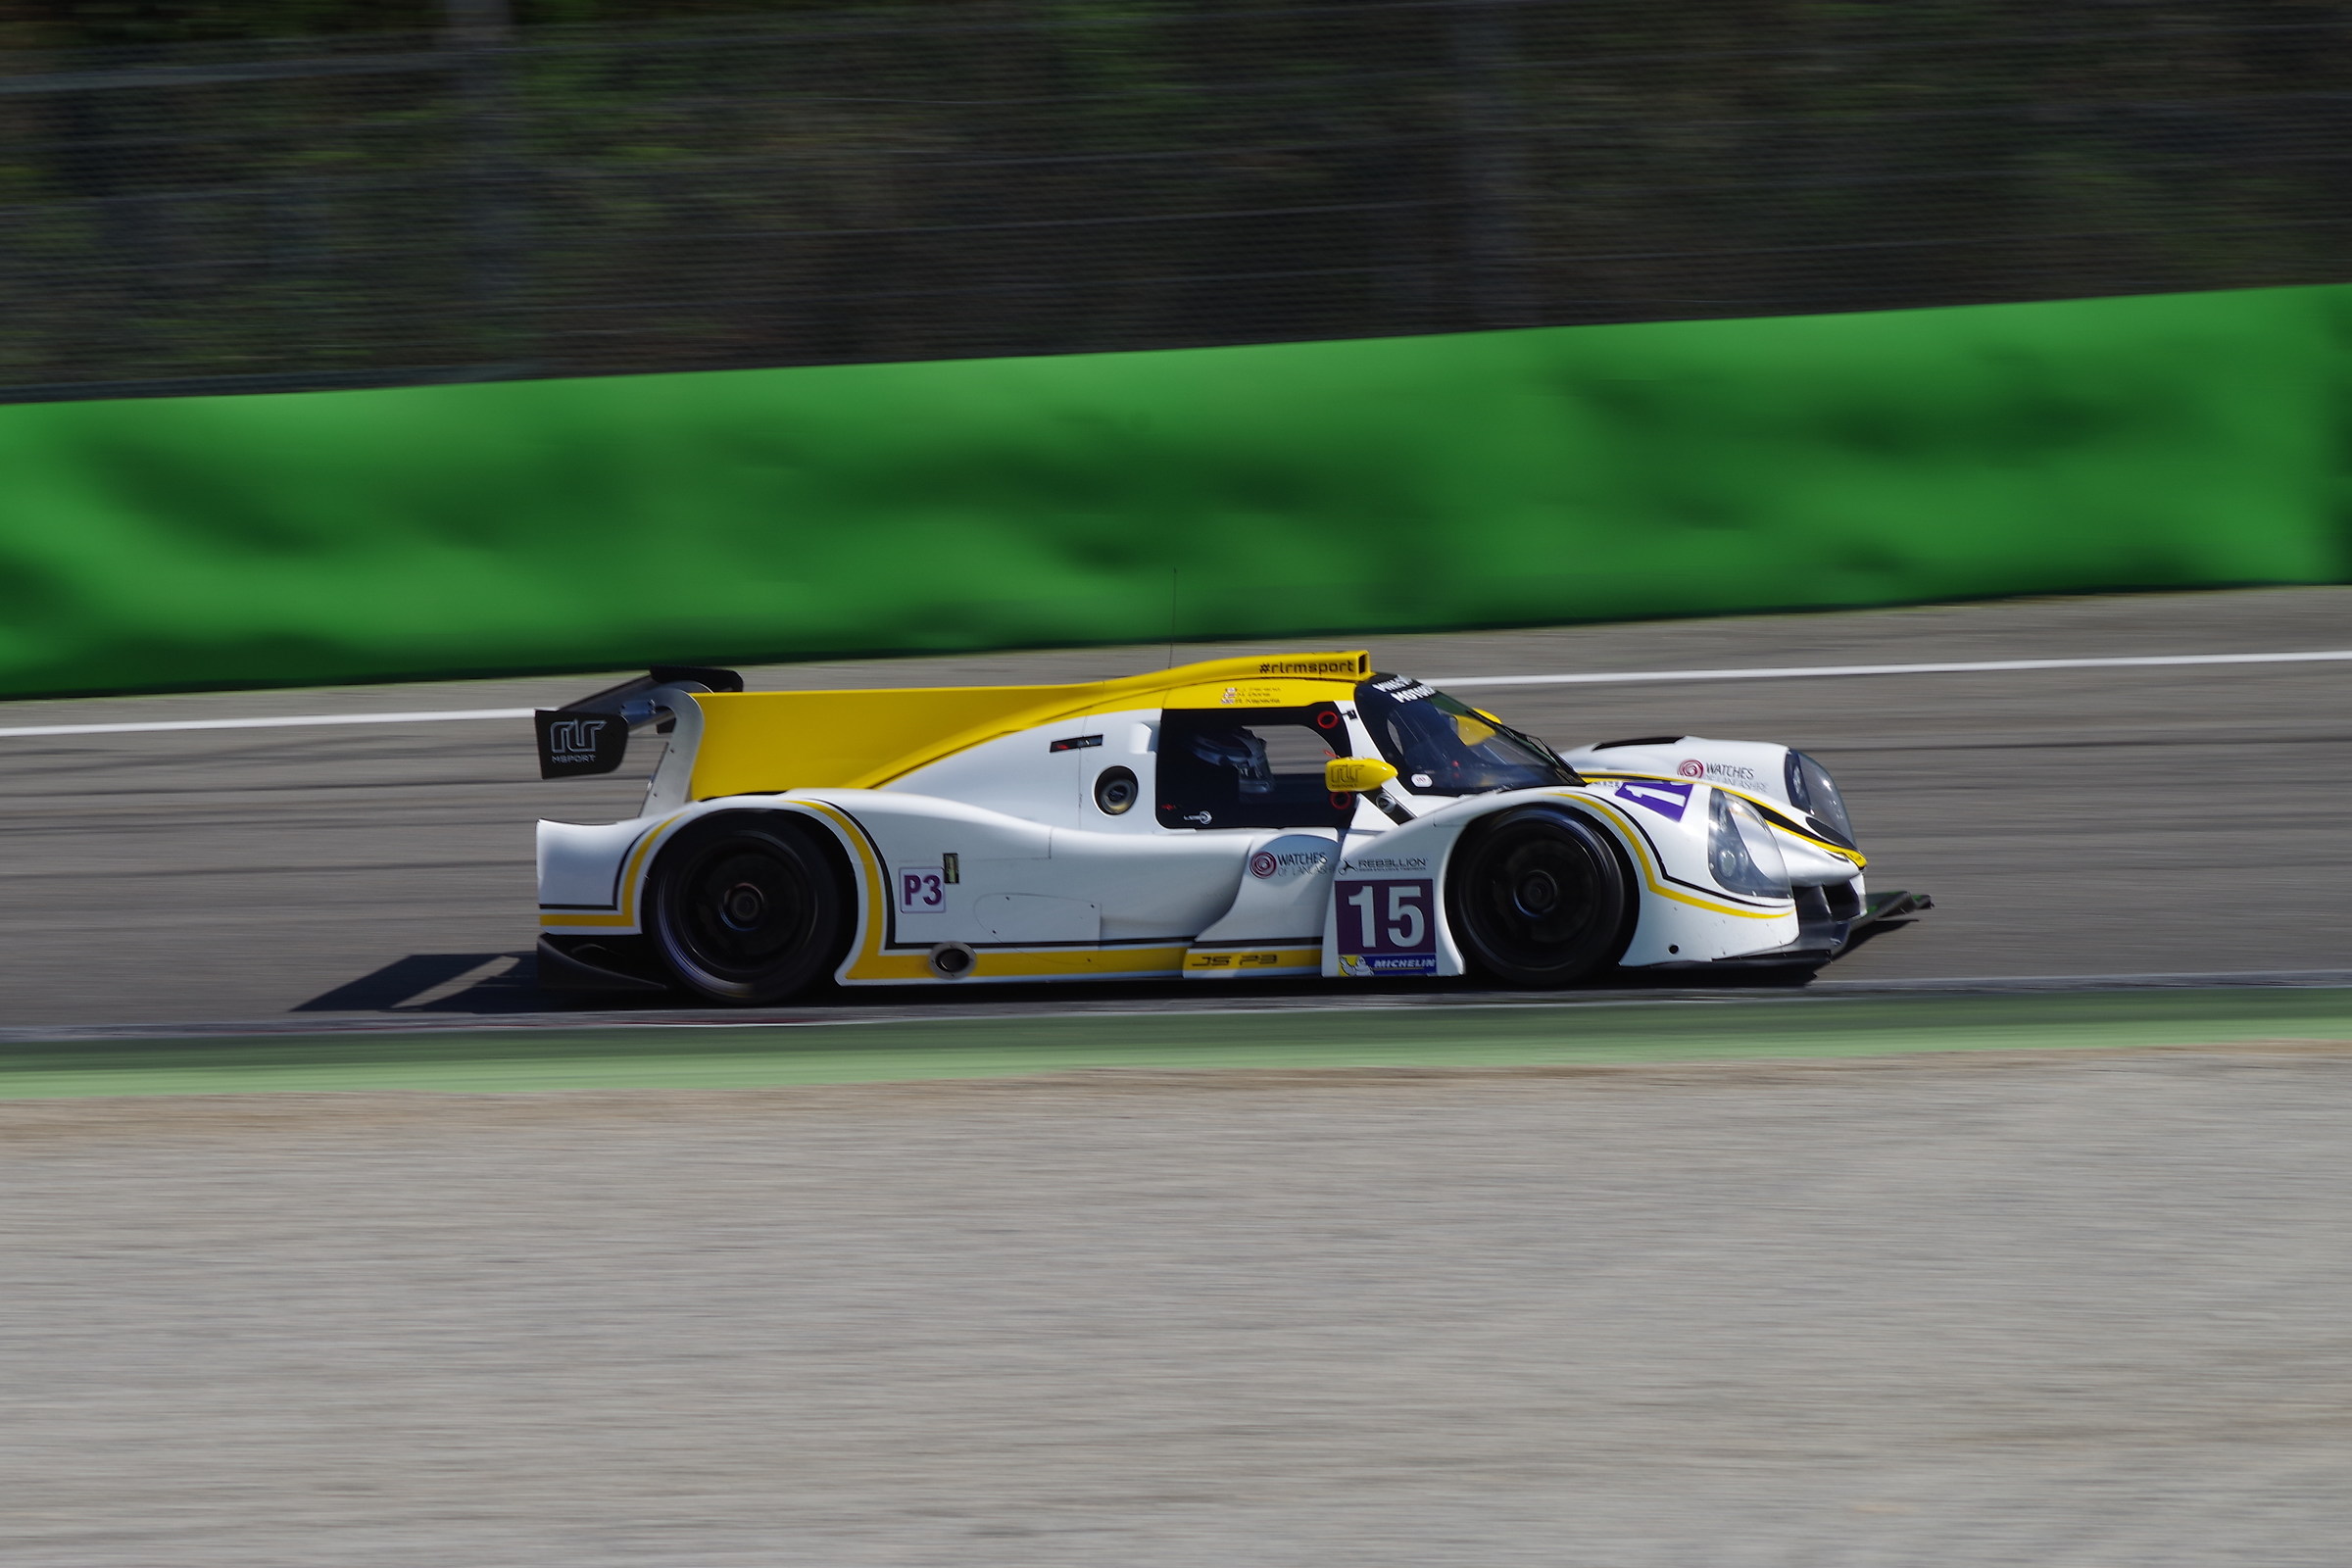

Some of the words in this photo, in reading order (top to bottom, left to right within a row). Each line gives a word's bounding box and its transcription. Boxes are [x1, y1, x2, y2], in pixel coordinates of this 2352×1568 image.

[1259, 661, 1354, 675] #rlrmsport
[1706, 761, 1754, 779] WATCHES
[1277, 852, 1328, 866] WATCHES
[904, 874, 942, 906] P3
[1348, 886, 1425, 948] 15
[1374, 959, 1436, 968] MICHELIN
